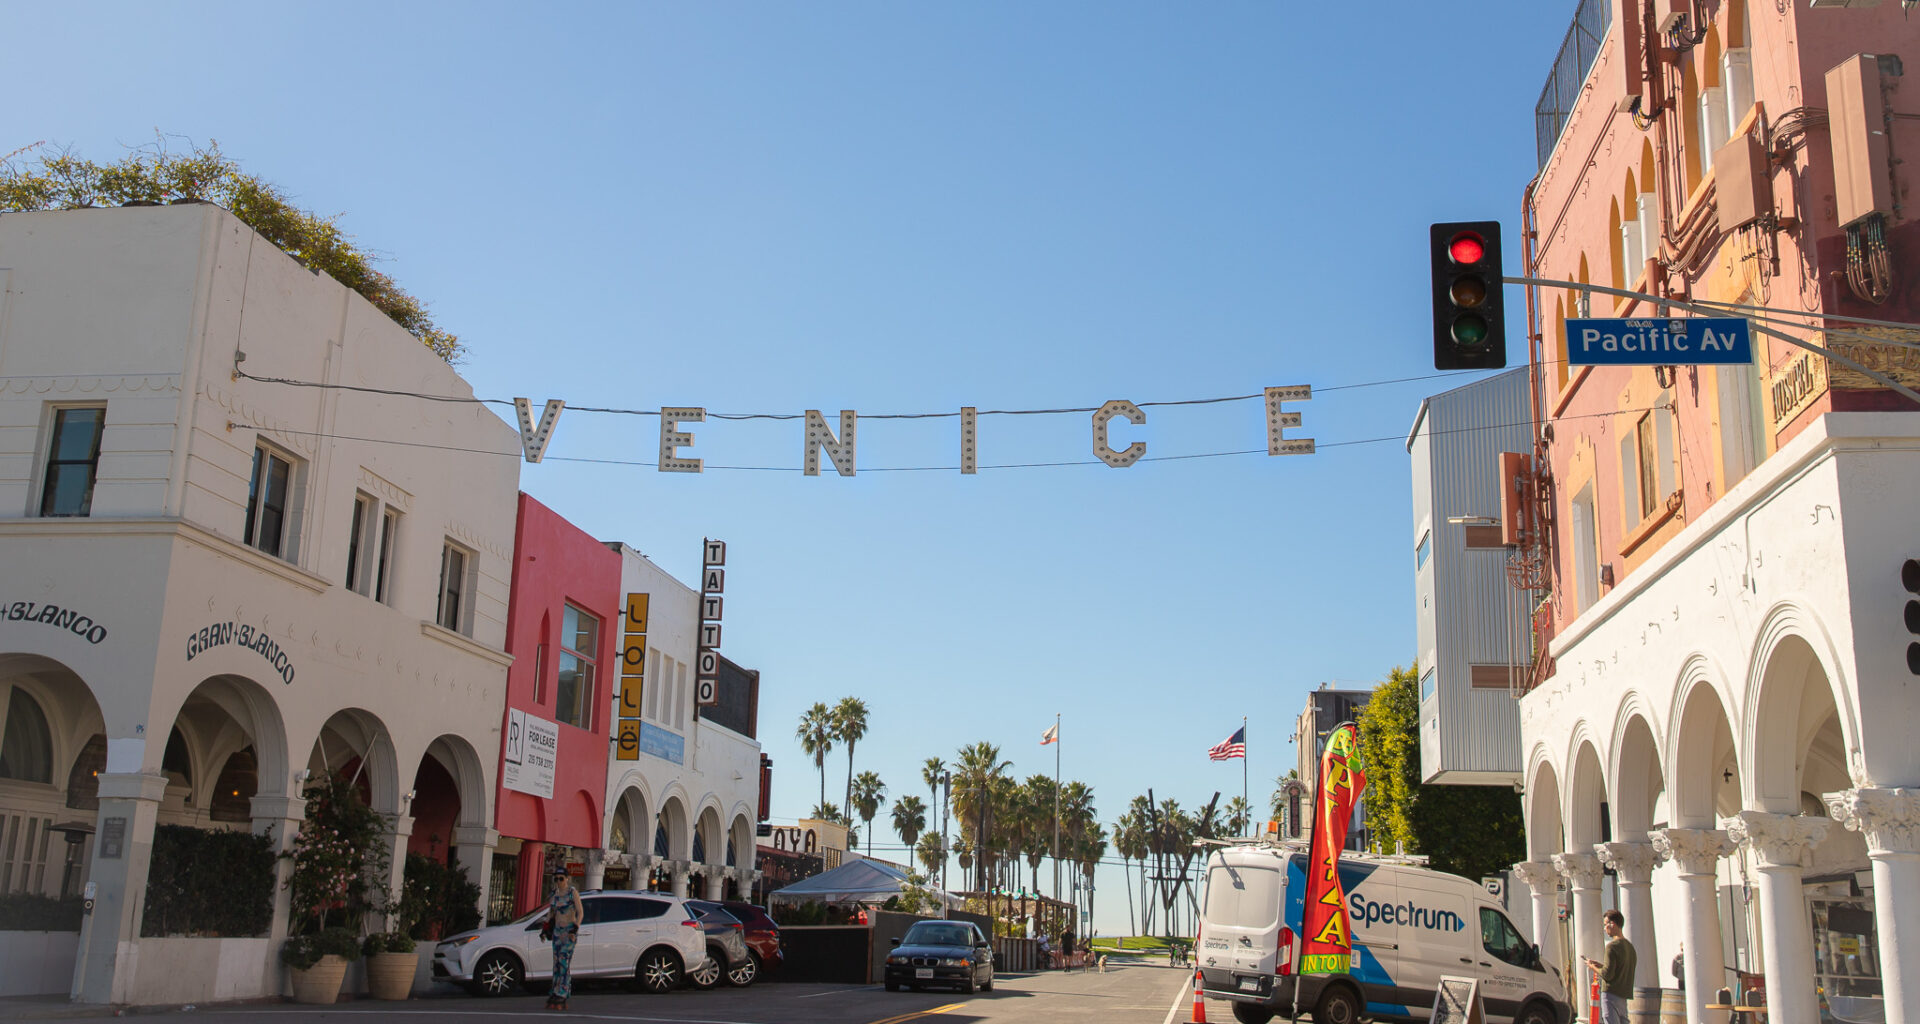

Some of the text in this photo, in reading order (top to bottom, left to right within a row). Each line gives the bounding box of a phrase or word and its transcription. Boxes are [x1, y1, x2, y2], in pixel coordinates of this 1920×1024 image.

[1582, 328, 1736, 351] Pacific Av
[1772, 354, 1814, 424] HOSTEL
[513, 385, 1316, 477] VENICE
[8, 602, 107, 645] BLANCO
[700, 544, 721, 700] TATTOO
[187, 622, 294, 685] GRAN BLANCO
[529, 731, 555, 749] FOR LEASE
[1350, 893, 1458, 932] Spectrum
[1205, 940, 1226, 950] Spectrum
[1303, 956, 1317, 972] IN
